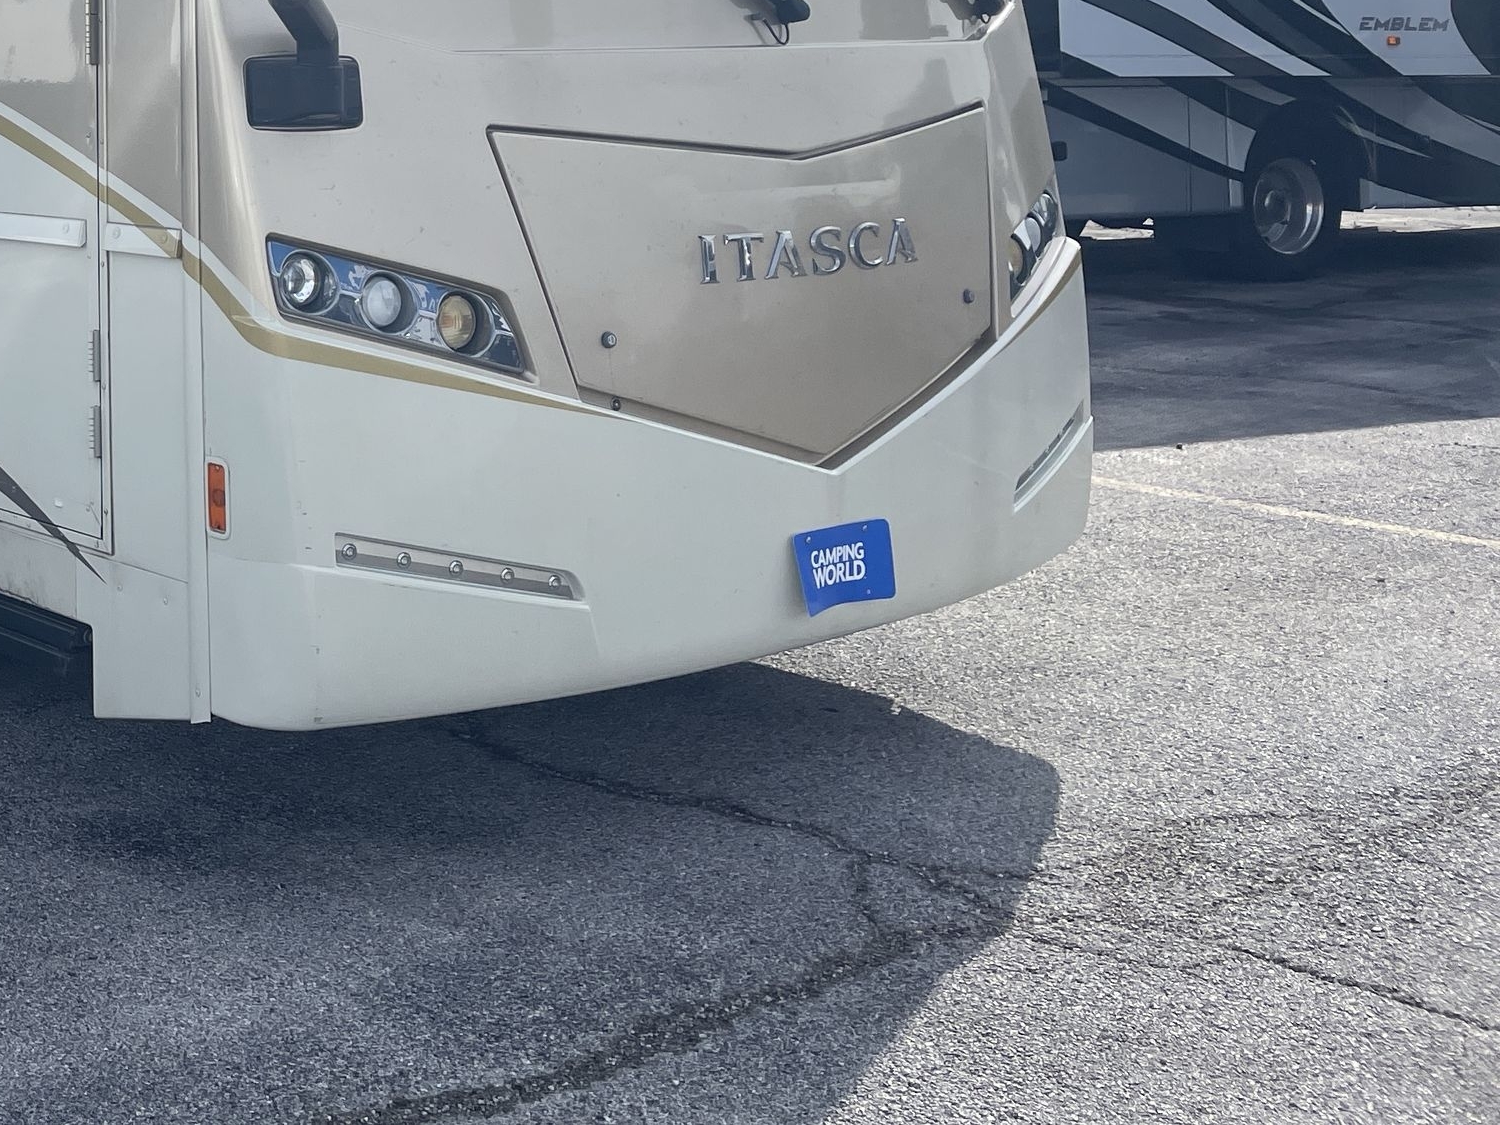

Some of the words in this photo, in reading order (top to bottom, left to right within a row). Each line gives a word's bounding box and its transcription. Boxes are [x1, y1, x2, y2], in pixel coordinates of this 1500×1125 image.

[1358, 16, 1450, 32] EMBLEM
[698, 217, 918, 284] ITASCA
[810, 542, 865, 568] CAMPING
[812, 560, 866, 589] WORLD
